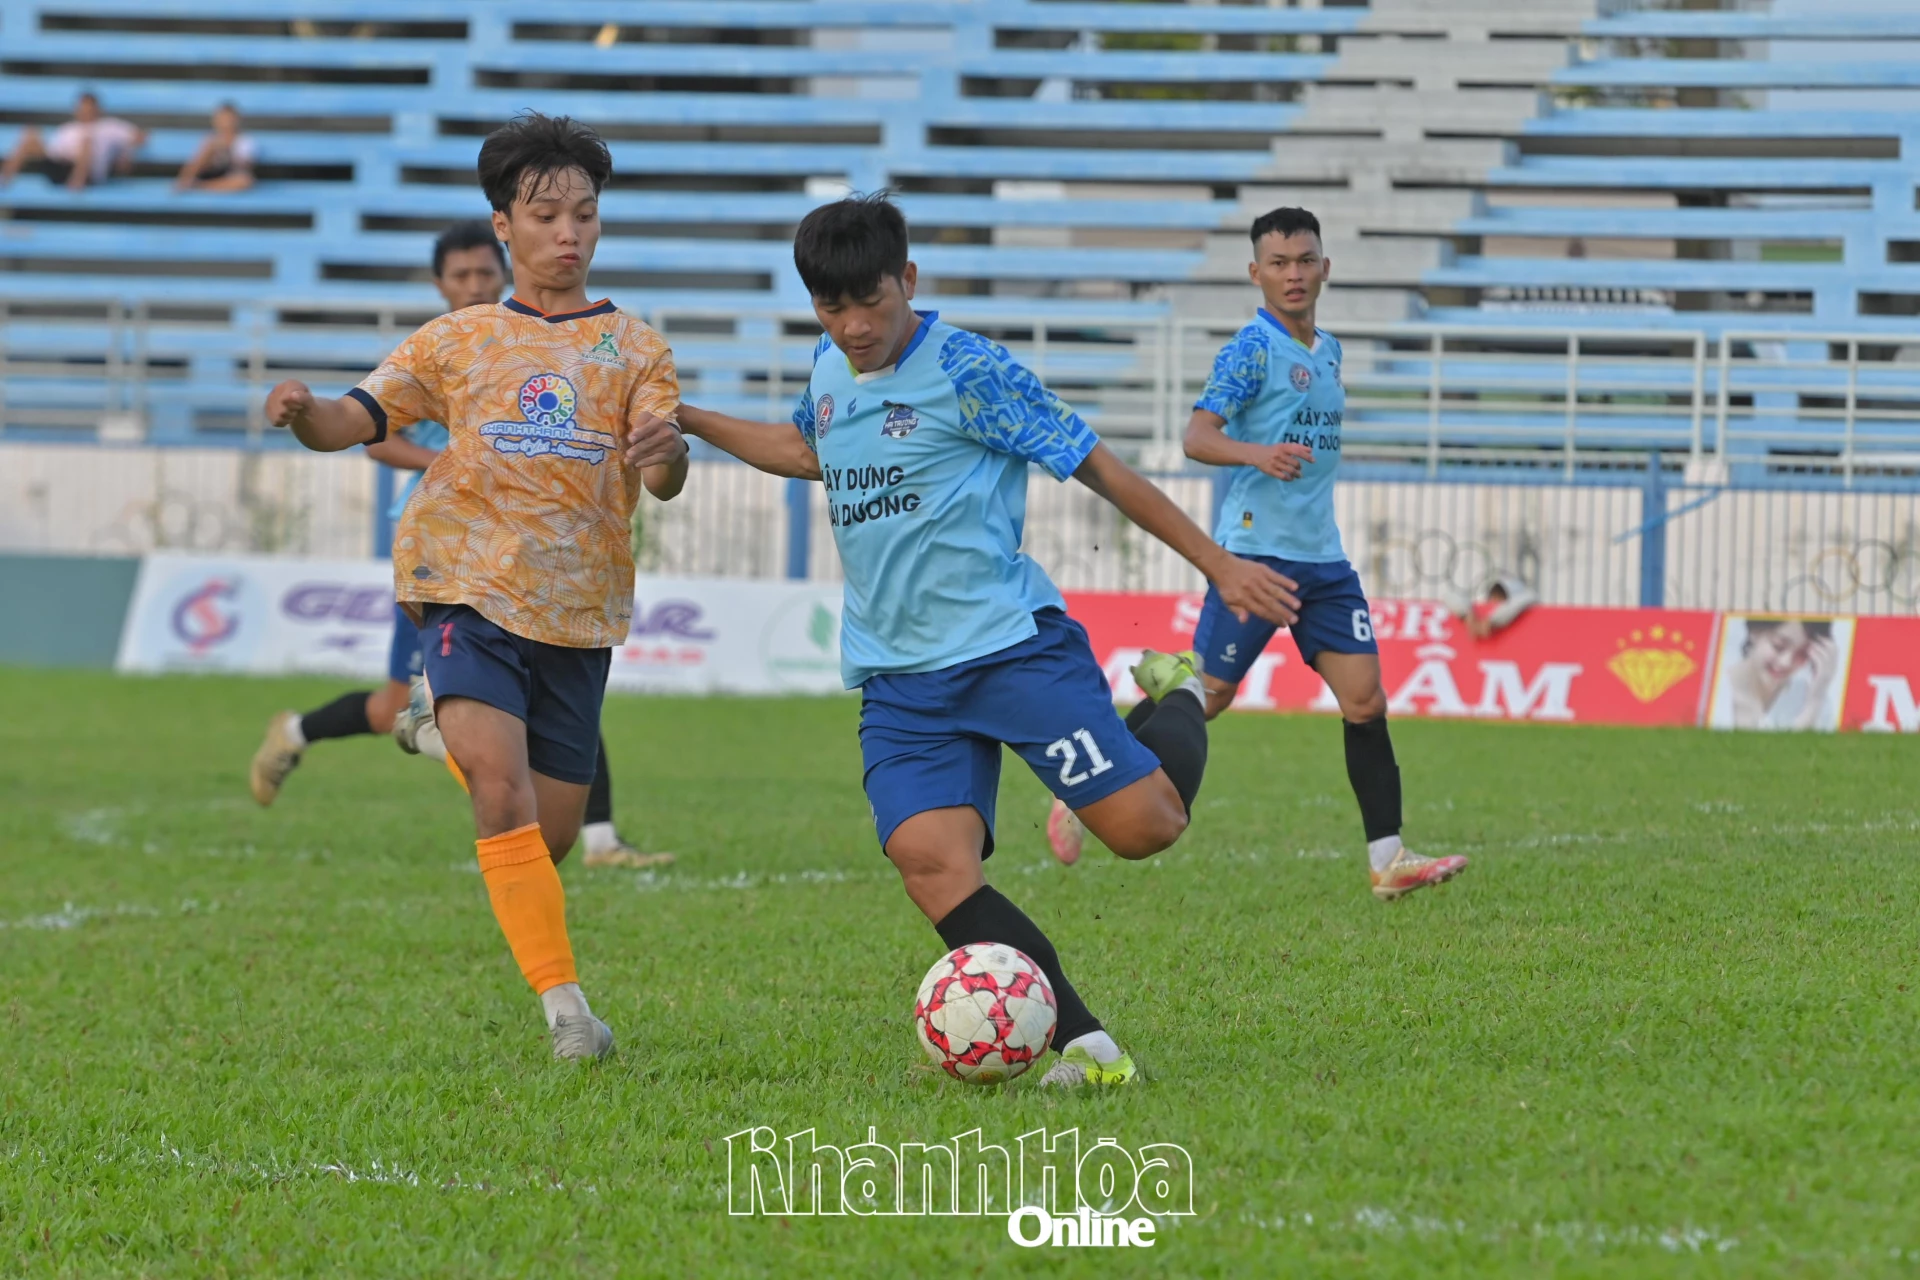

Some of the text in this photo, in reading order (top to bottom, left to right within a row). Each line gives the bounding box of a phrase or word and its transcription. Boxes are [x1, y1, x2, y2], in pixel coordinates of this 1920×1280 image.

[1293, 407, 1320, 426] XÂY
[821, 463, 904, 496] ÂY DỰNG
[842, 493, 921, 526] DƯƠNG
[1045, 727, 1114, 788] 21
